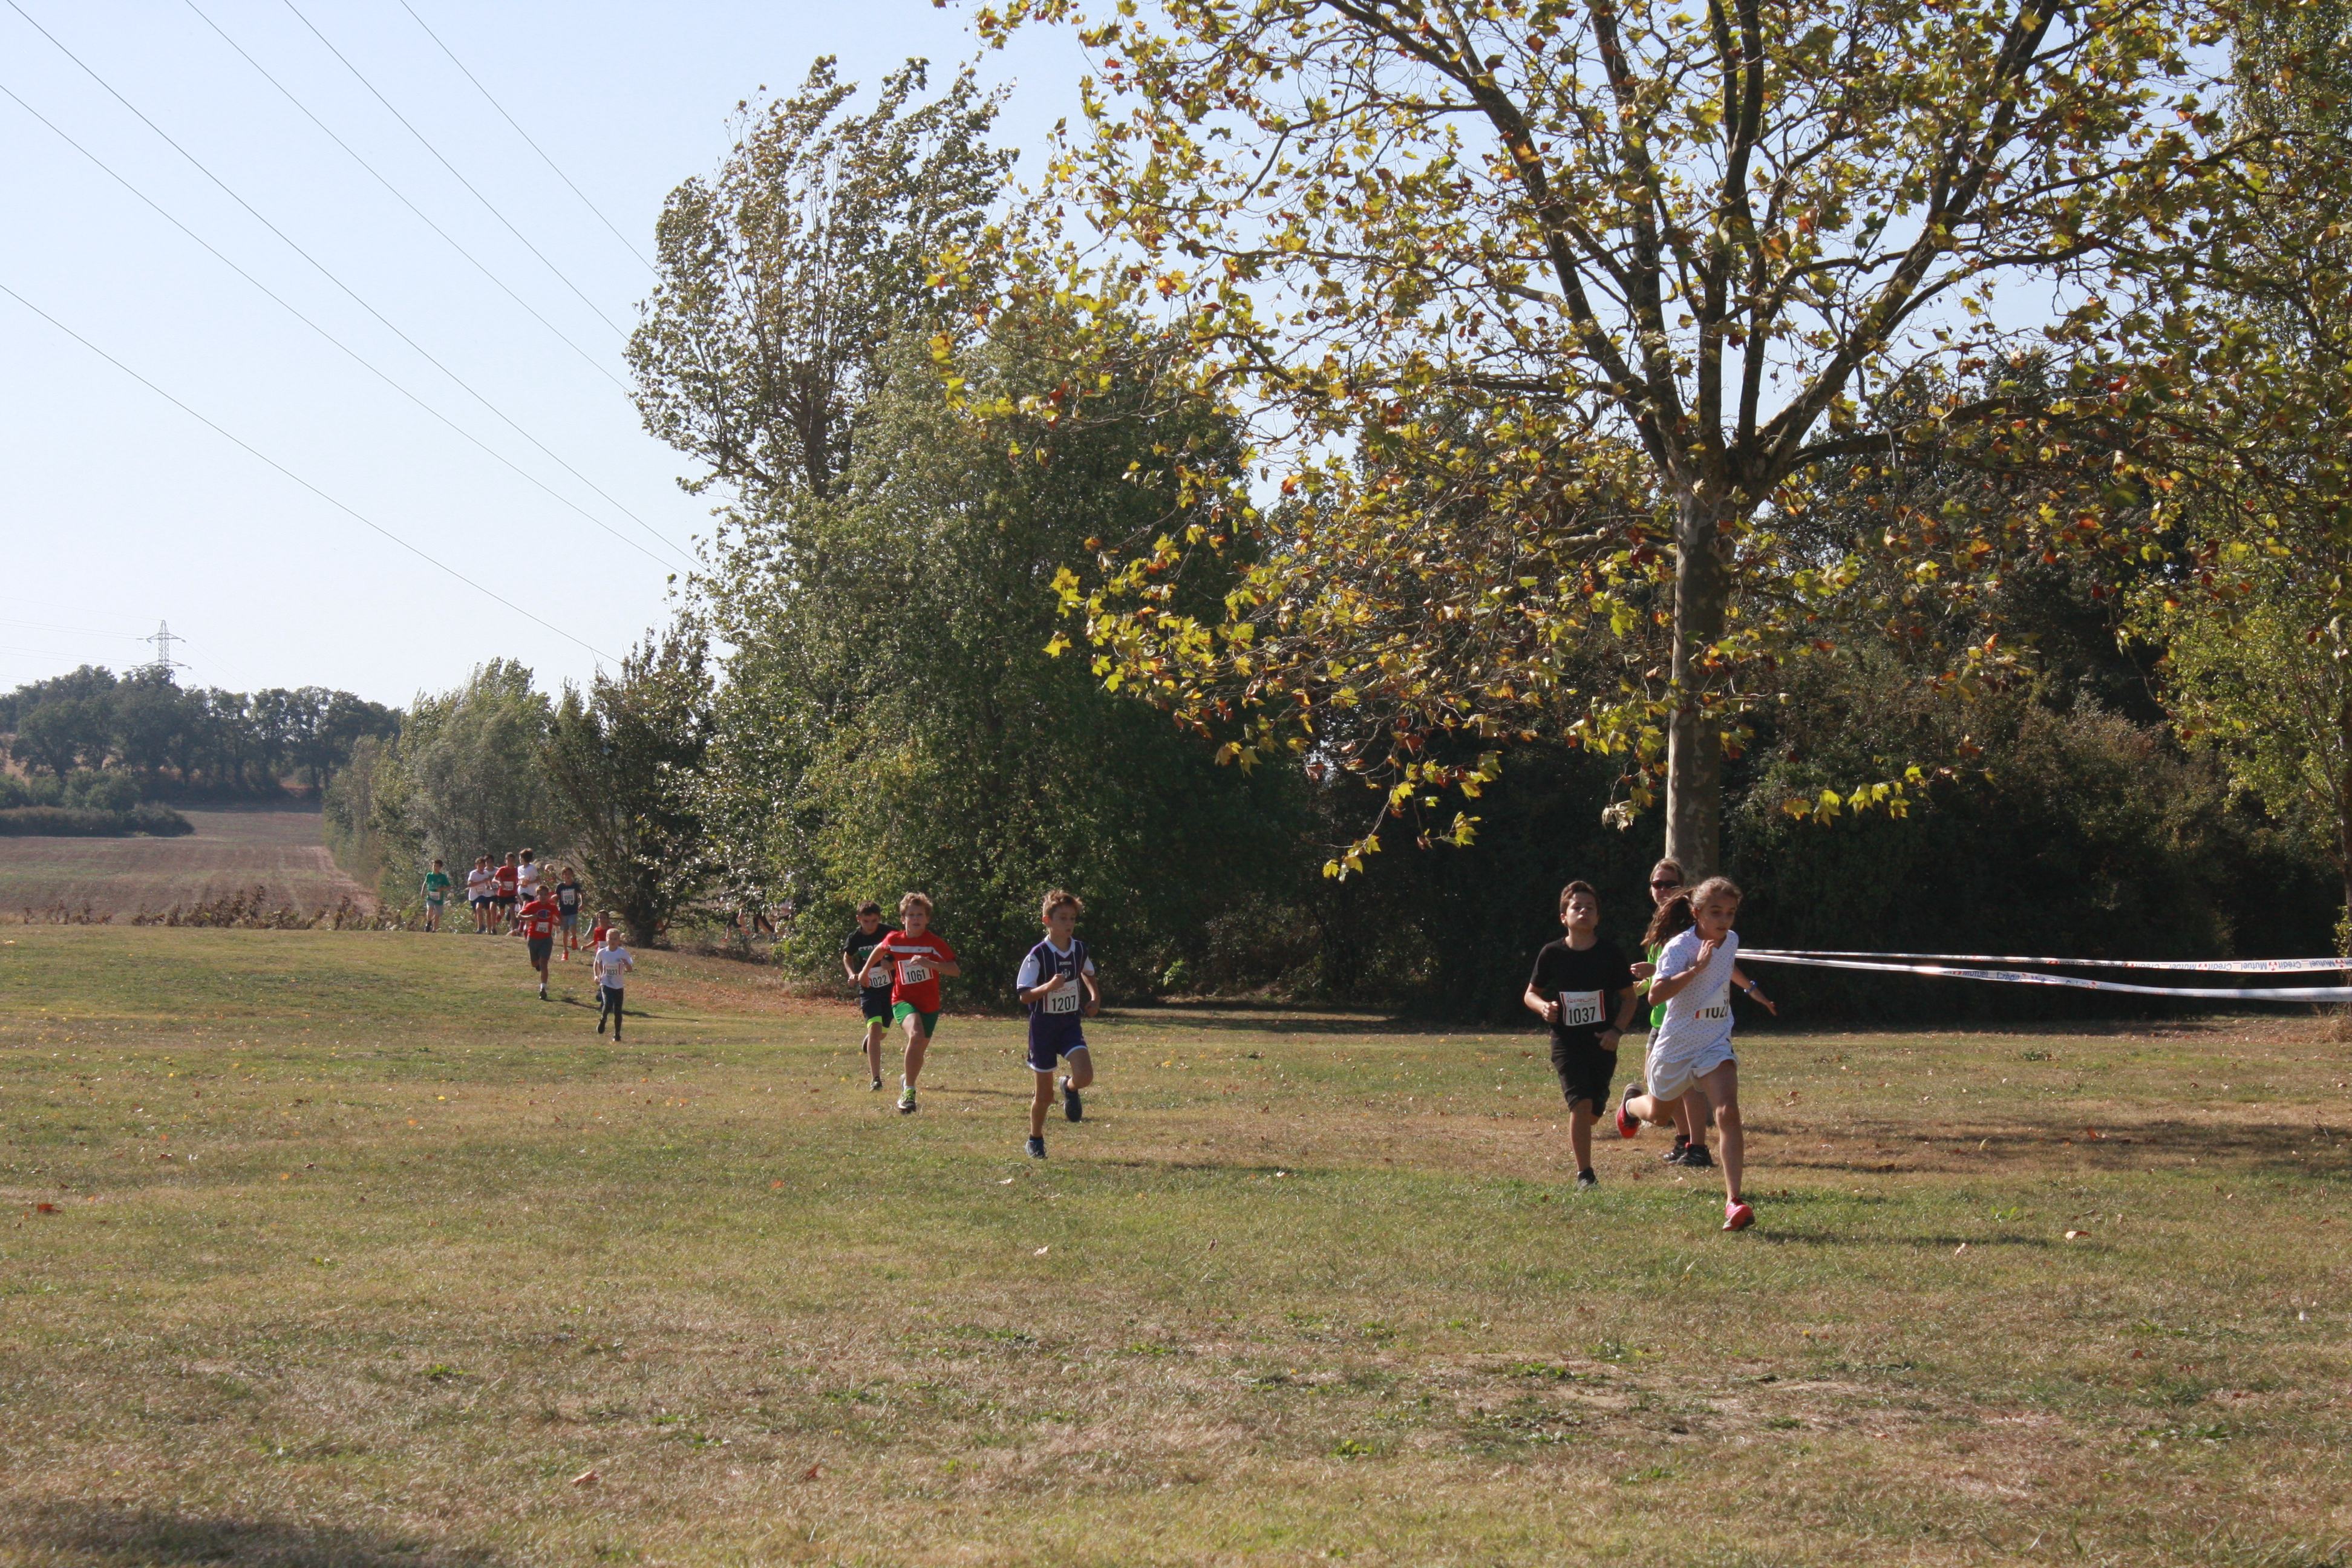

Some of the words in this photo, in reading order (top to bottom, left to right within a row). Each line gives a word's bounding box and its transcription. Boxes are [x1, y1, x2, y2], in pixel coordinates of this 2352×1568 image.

[2241, 962, 2267, 970] Mutuel
[2278, 961, 2302, 970] Crédit
[870, 975, 887, 987] 1022
[907, 969, 926, 982] 1061
[1052, 995, 1076, 1011] 1207
[1569, 1007, 1596, 1024] 1037
